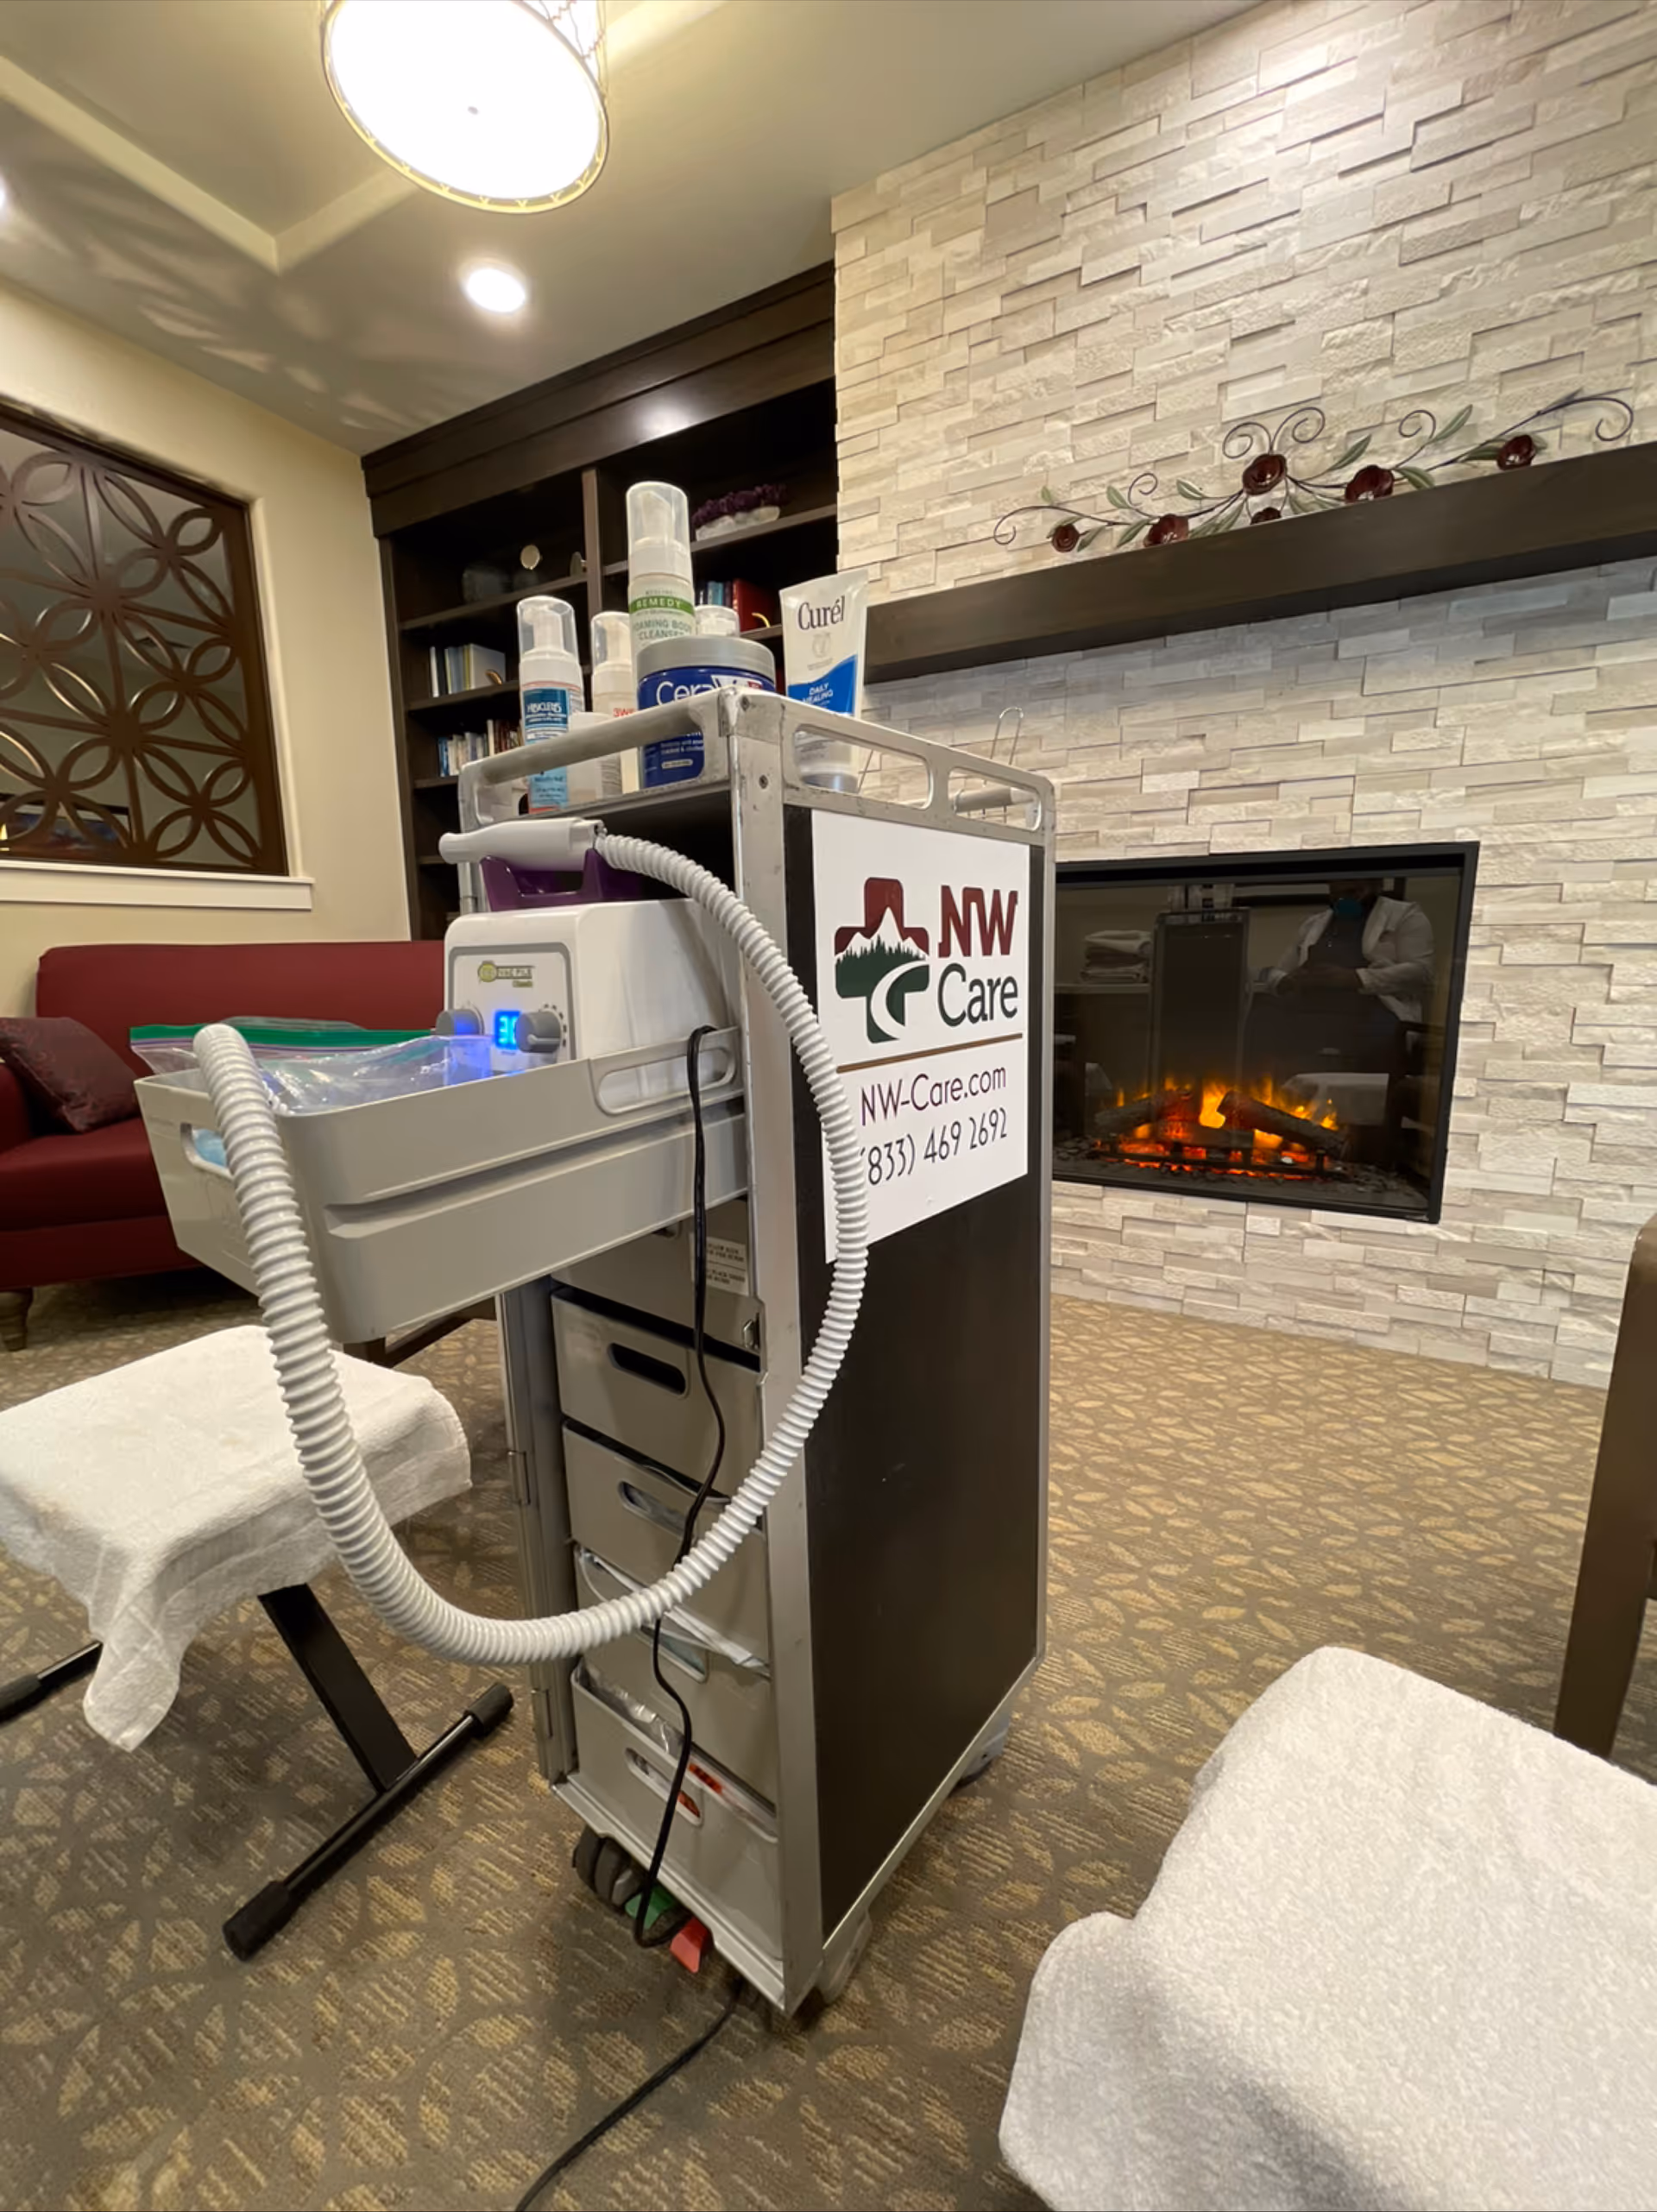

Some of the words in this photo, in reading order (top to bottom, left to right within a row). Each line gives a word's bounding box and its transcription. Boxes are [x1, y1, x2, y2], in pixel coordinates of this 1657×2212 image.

[636, 597, 681, 608] REMEDY
[798, 596, 845, 630] Curél
[809, 683, 829, 695] DAILY
[938, 885, 1018, 958] NW
[938, 963, 1018, 1026] Care
[861, 1067, 1006, 1125] NW-Care.com
[924, 1128, 961, 1163] 469
[970, 1106, 1007, 1150] 2692
